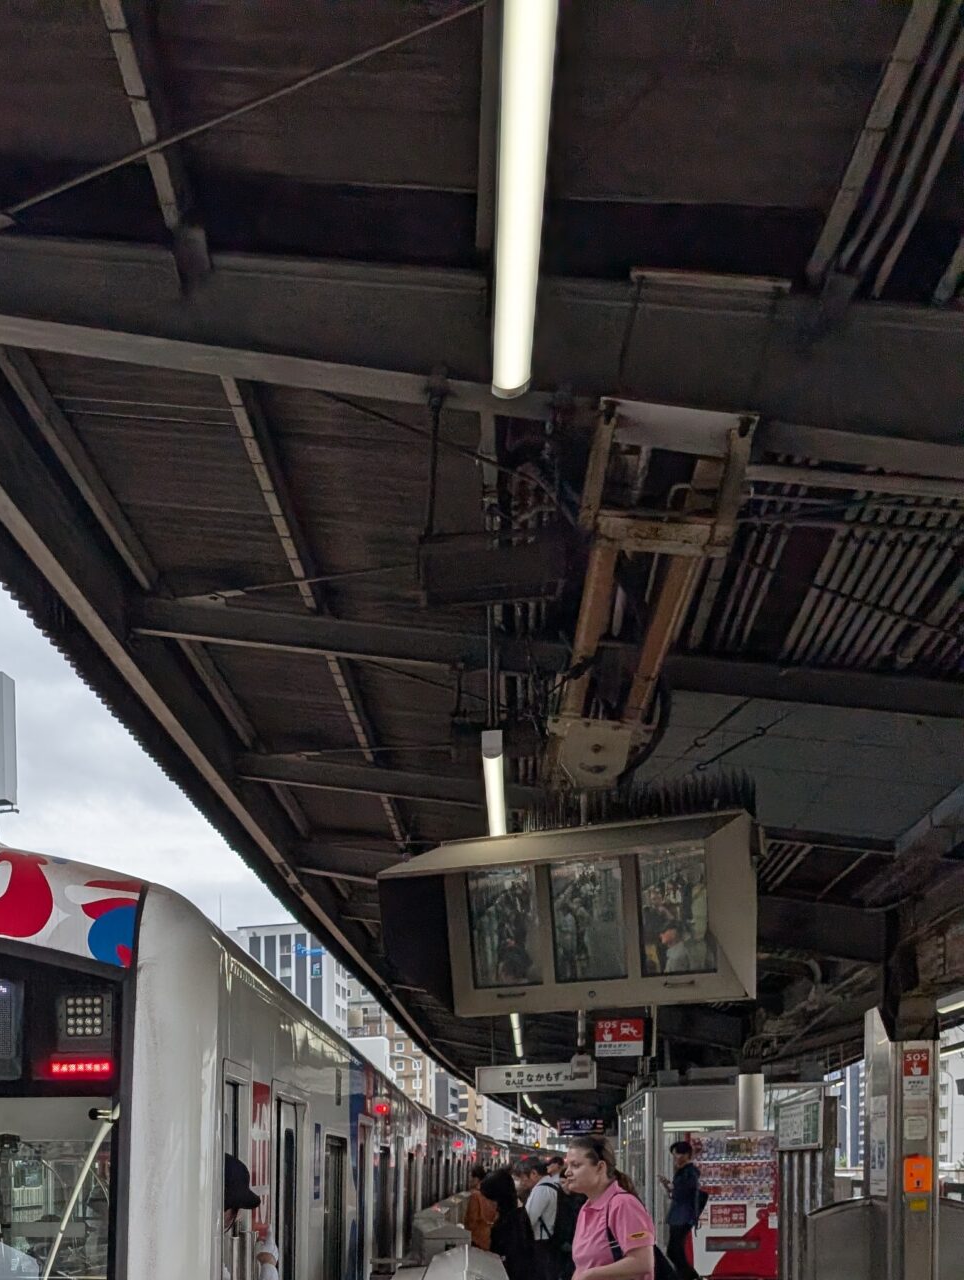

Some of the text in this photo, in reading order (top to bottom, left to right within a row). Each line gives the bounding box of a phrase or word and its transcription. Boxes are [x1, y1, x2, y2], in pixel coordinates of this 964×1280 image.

[597, 1021, 617, 1029] SOS
[906, 1053, 927, 1062] SOS
[526, 1072, 562, 1082] なかもず
